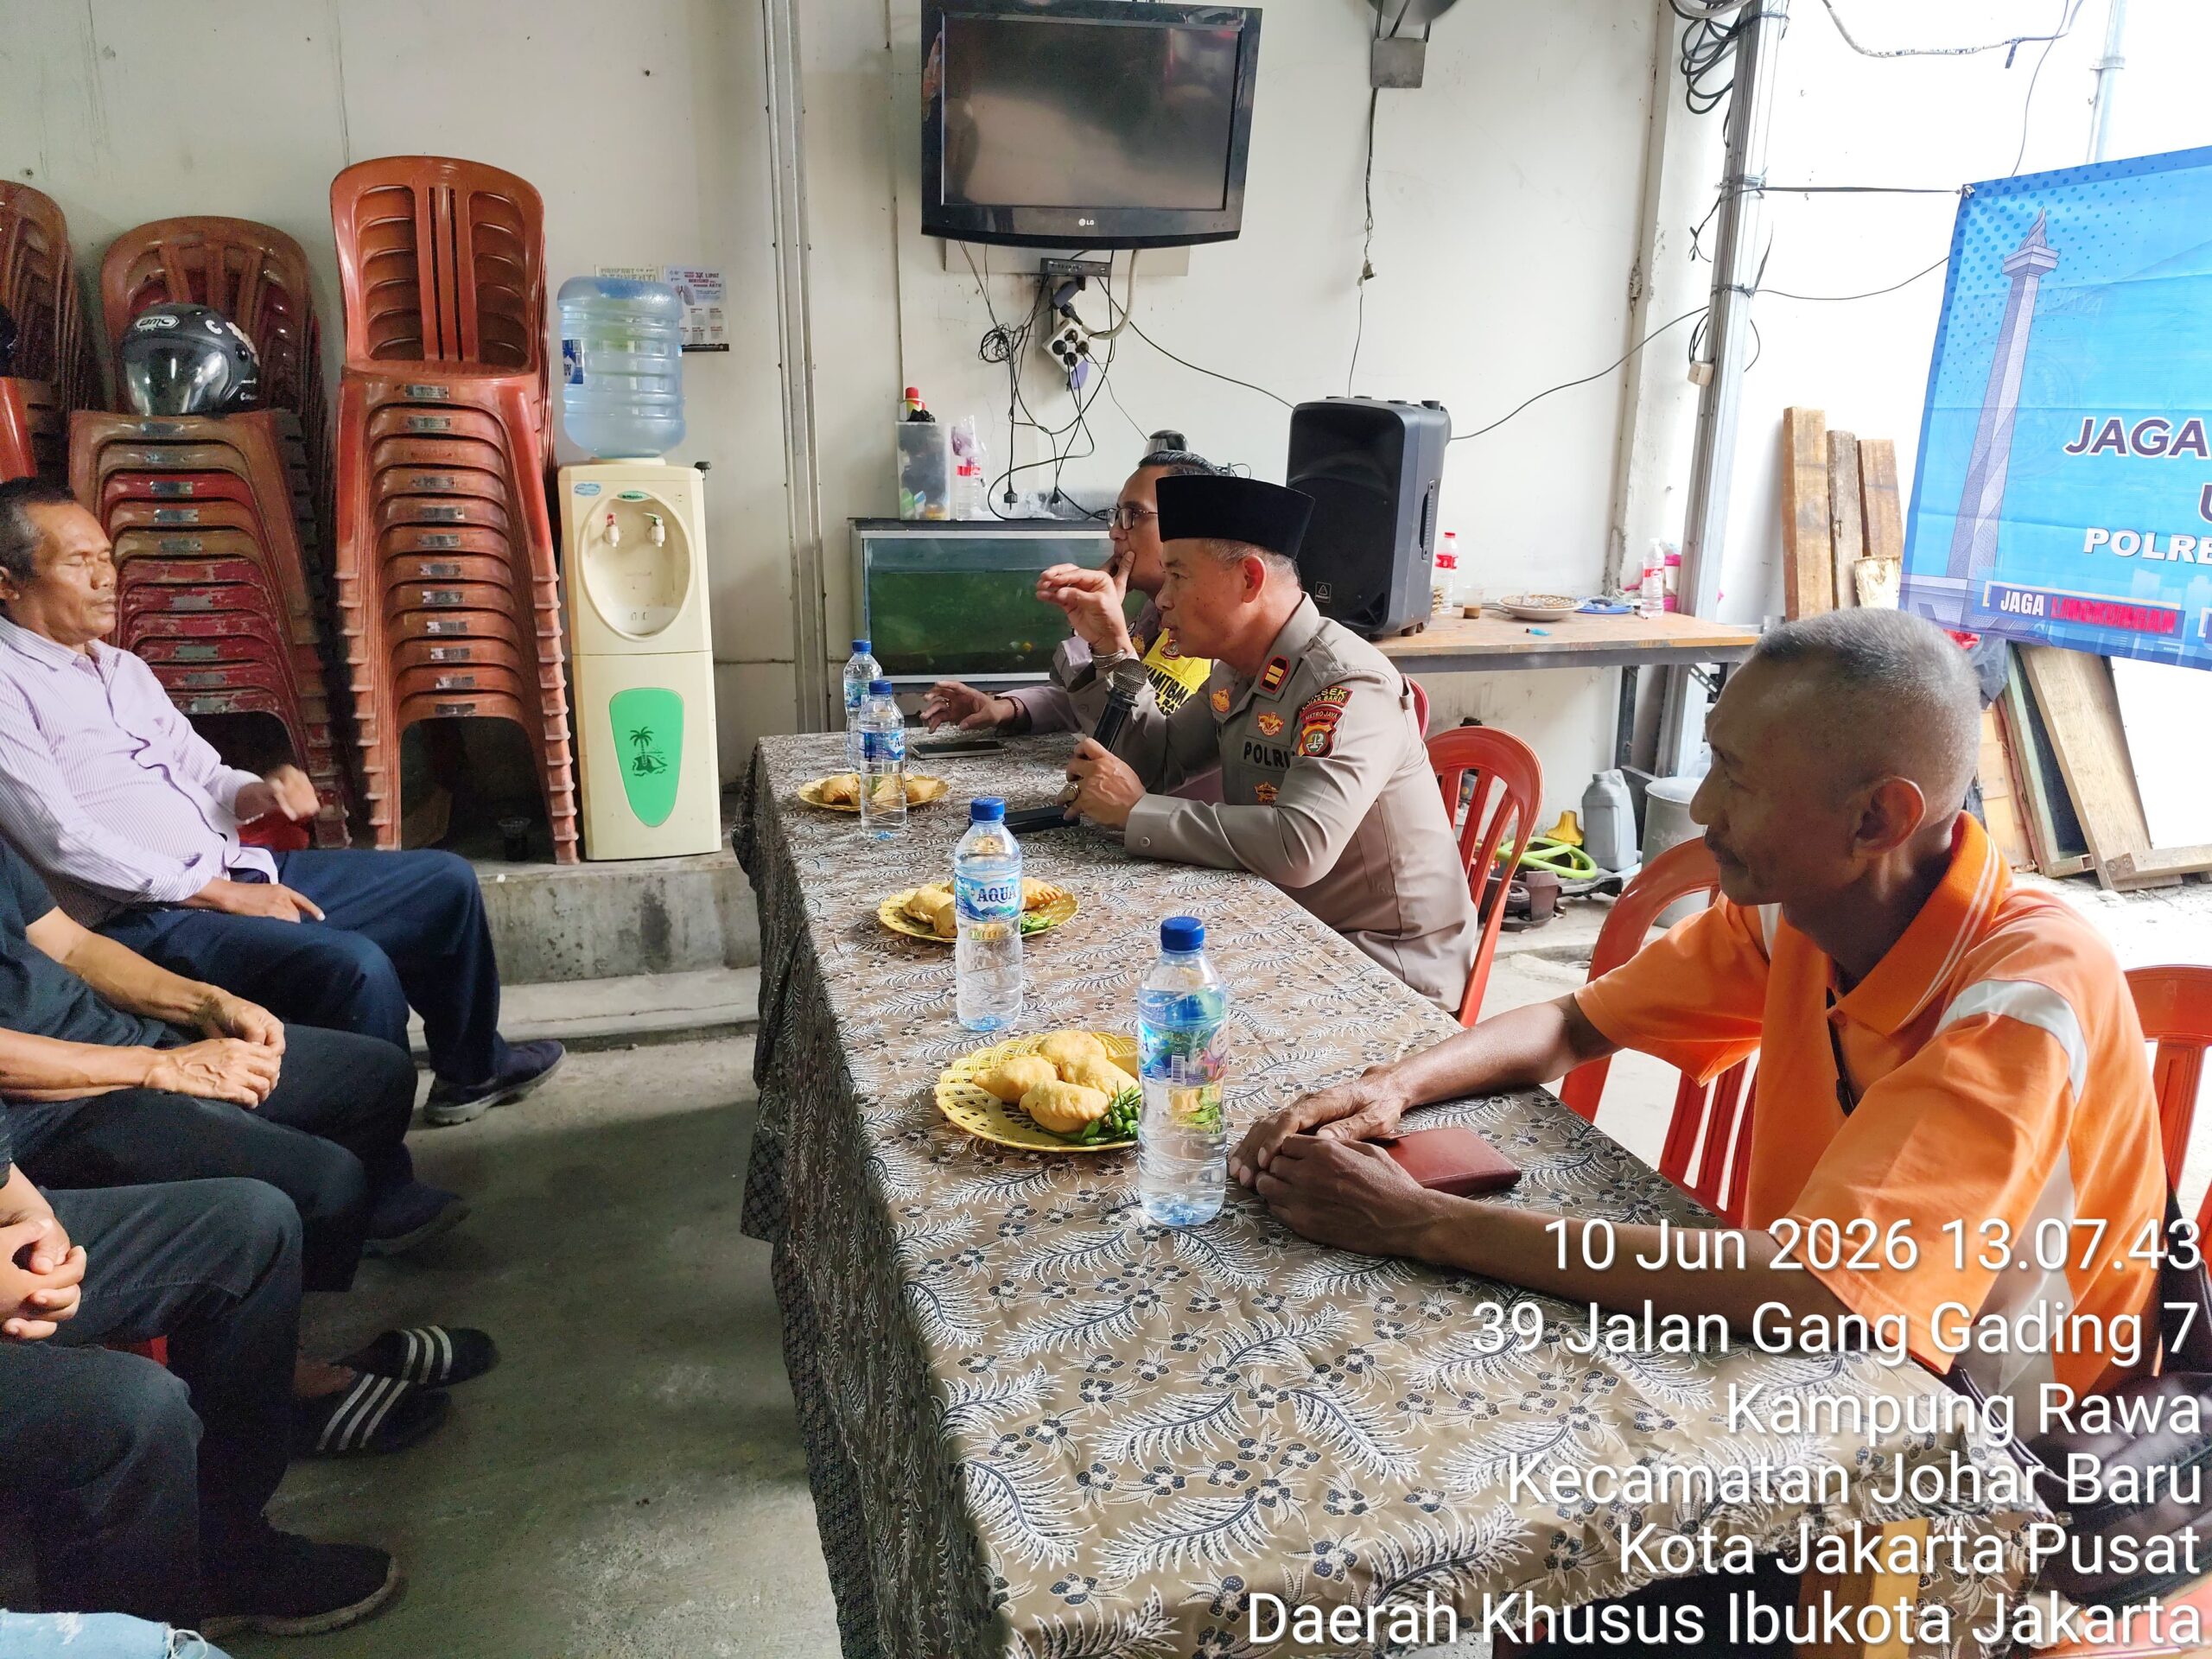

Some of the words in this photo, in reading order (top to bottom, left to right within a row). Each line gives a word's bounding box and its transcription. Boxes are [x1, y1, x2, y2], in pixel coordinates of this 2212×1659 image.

[2063, 416, 2212, 460] JAGA
[2000, 590, 2044, 617] JAGA
[1306, 711, 1323, 721] METRO
[1324, 711, 1338, 720] JAYA
[1243, 741, 1290, 769] POLRI
[977, 884, 1017, 903] AQUA
